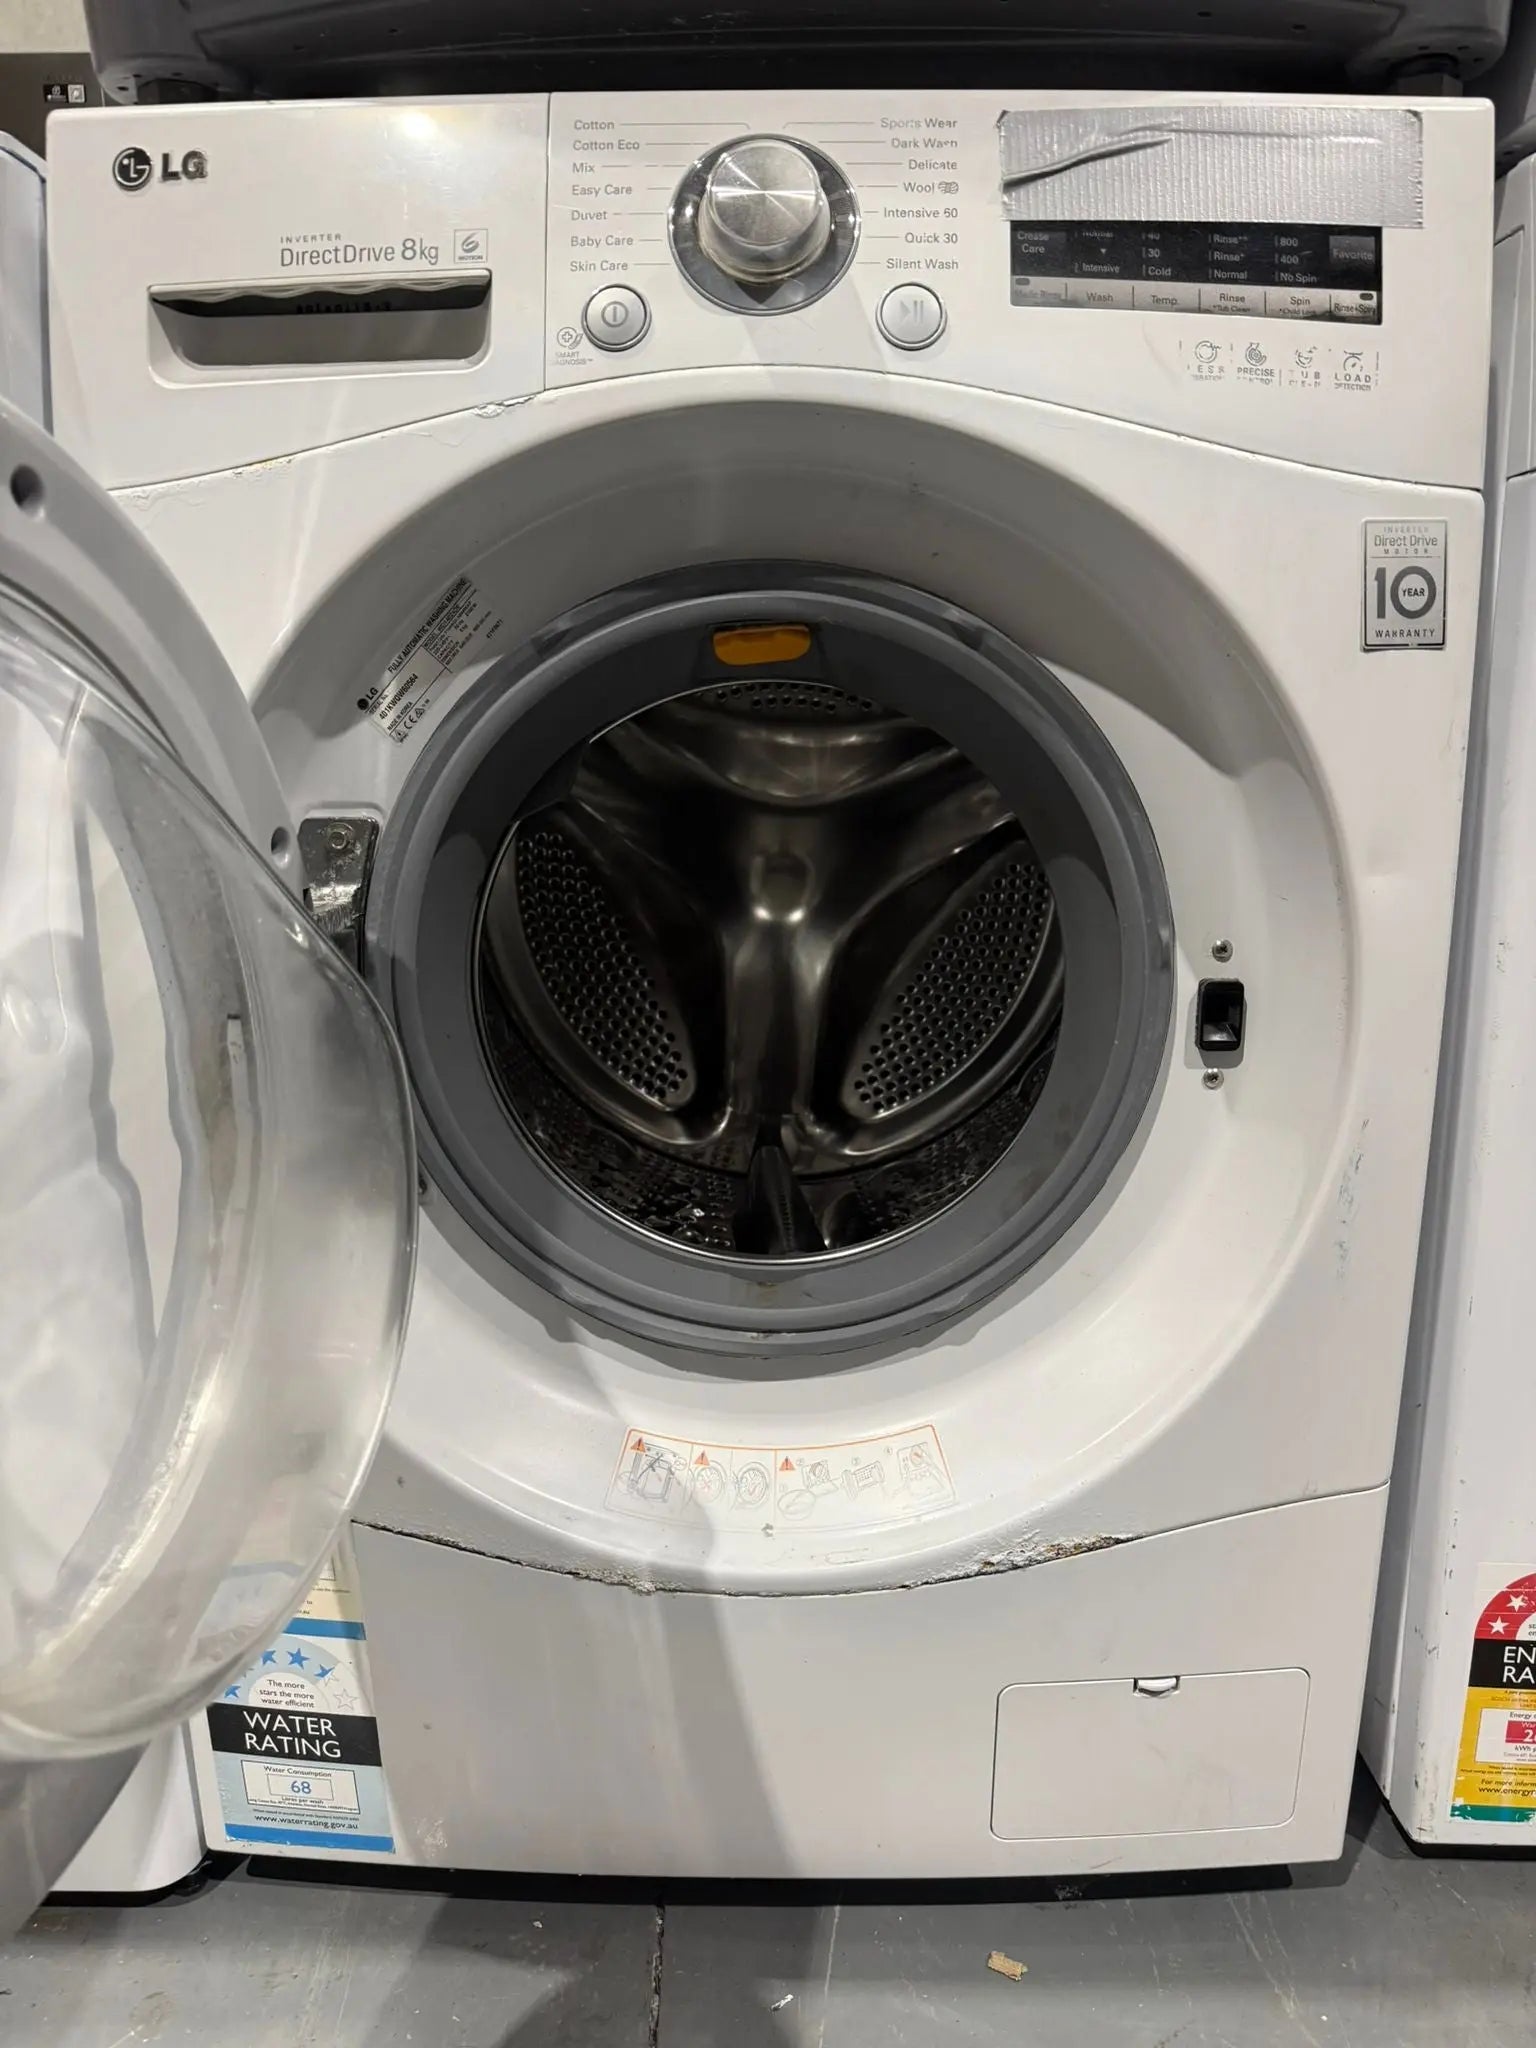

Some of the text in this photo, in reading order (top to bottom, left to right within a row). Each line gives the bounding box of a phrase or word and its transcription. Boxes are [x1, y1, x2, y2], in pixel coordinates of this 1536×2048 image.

[574, 120, 614, 130] Cotton
[924, 118, 958, 128] Wear
[573, 139, 640, 151] Cotton Eco
[891, 137, 920, 148] Dark
[161, 151, 208, 181] LG
[572, 162, 595, 173] Mix
[908, 159, 958, 170] Delicate
[572, 184, 632, 197] Easy Care
[903, 182, 935, 193] Wool
[571, 210, 607, 221] Duvet
[883, 207, 940, 218] Intensive
[281, 233, 342, 244] INVERTER
[570, 235, 634, 248] Baby Care
[904, 232, 958, 244] Quick 30
[1017, 231, 1049, 253] Crease Care
[1280, 237, 1298, 246] 800
[1148, 249, 1160, 258] 30
[1333, 250, 1373, 260] Favorite
[886, 258, 959, 269] Silent Wash
[1280, 255, 1299, 264] 400
[570, 260, 628, 272] Skin Care
[1082, 263, 1120, 274] Intensive
[1148, 267, 1172, 277] Cold
[1214, 269, 1247, 280] Normal
[1280, 272, 1317, 283] No Spin
[1087, 292, 1113, 302] Wash
[1220, 293, 1246, 303] Rinse
[1290, 297, 1311, 306] Spin
[1237, 367, 1275, 377] PRECISE
[1374, 535, 1438, 547] Direct Drive
[1374, 565, 1437, 619] 10
[1401, 588, 1425, 597] YEAR
[387, 654, 404, 673] FULLY
[400, 624, 429, 657] AUTOMATIC
[424, 599, 449, 628] WASHING
[364, 686, 378, 700] LG
[267, 1679, 282, 1687] The
[259, 1689, 277, 1697] stars
[279, 1690, 292, 1698] the
[285, 1700, 314, 1708] efficient
[243, 1711, 336, 1737] WATER
[245, 1733, 341, 1758] RATING
[264, 1765, 332, 1777] Water Consumption
[291, 1780, 312, 1794] 68
